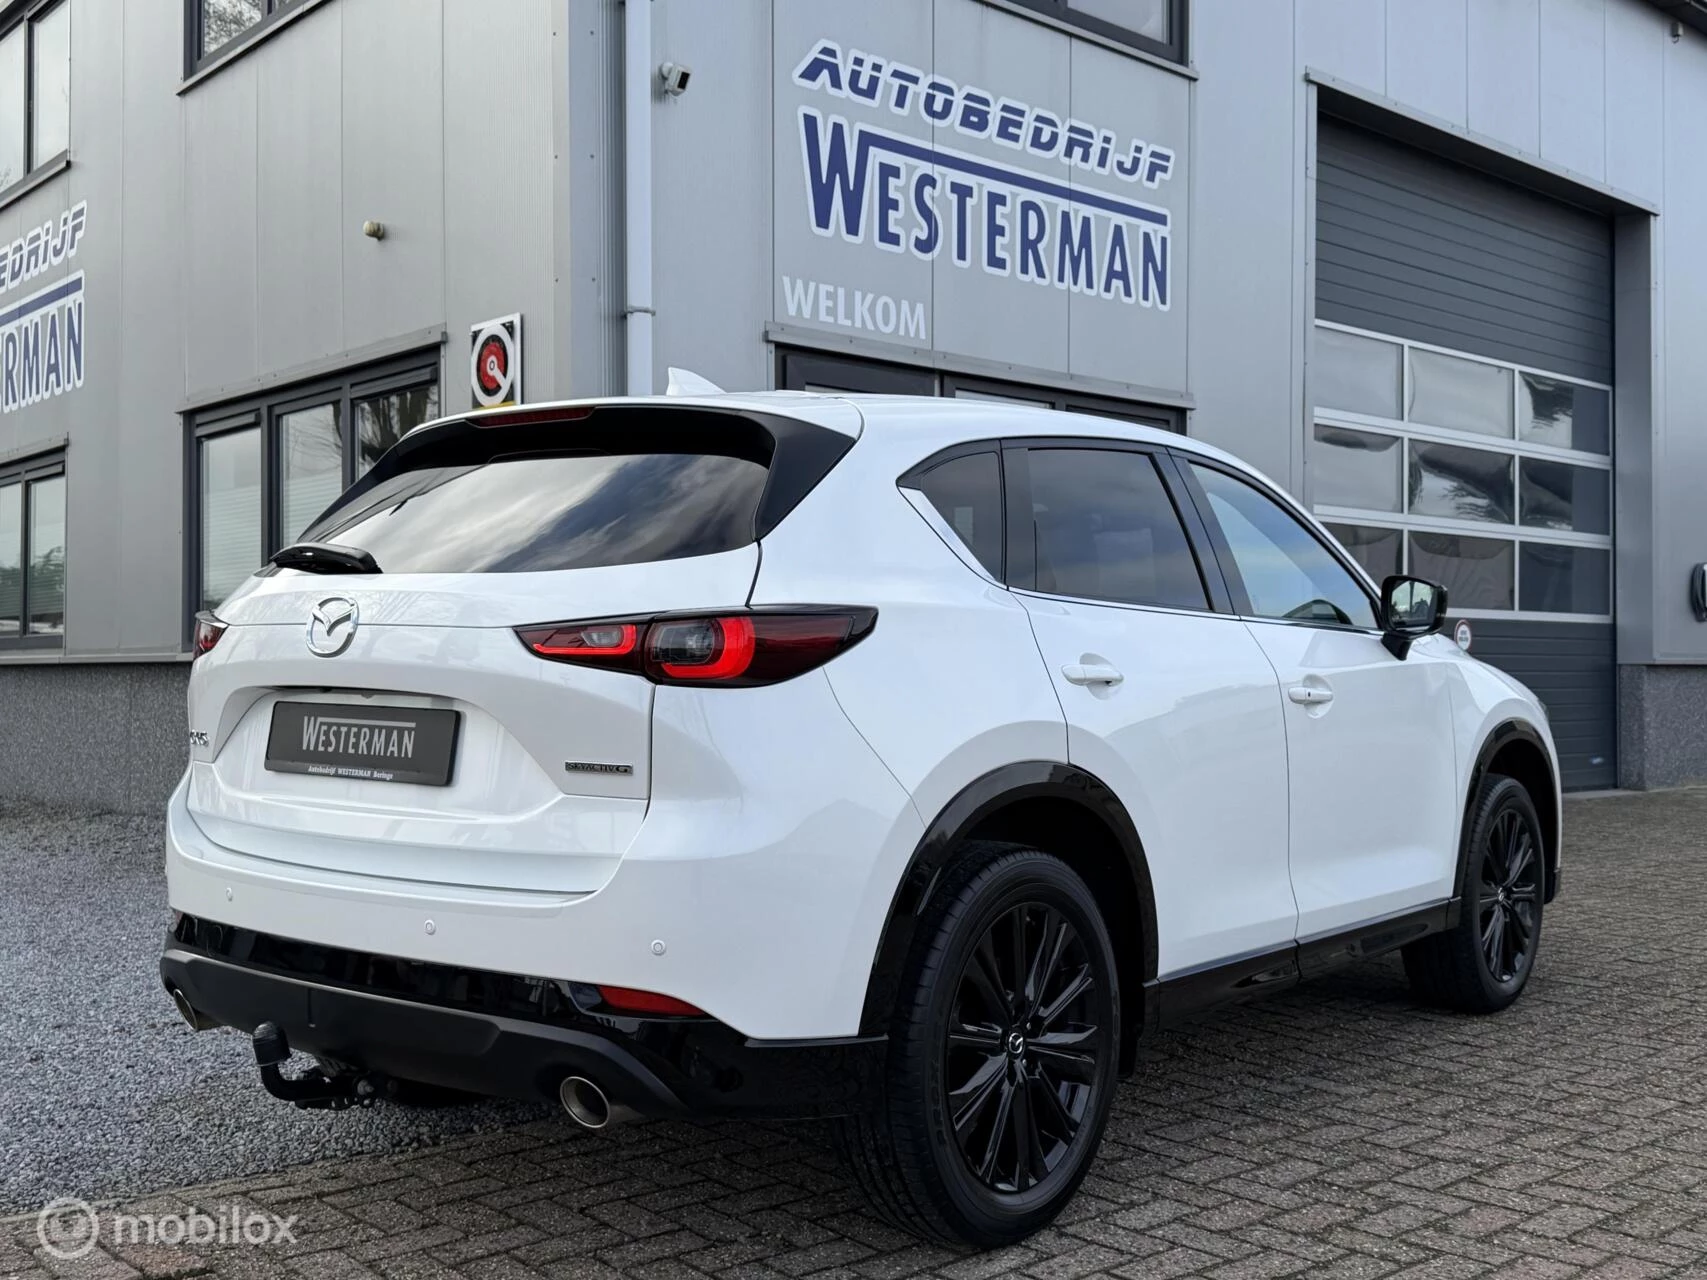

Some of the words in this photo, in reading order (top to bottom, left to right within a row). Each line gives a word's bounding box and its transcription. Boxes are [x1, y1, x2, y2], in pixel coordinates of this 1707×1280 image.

[796, 43, 1173, 186] AUTOBEDRIJF
[801, 109, 1170, 309] WESTERMAN
[782, 276, 926, 340] WELKOM
[302, 715, 417, 758] WESTERMAN
[337, 767, 372, 777] WESTERMAN
